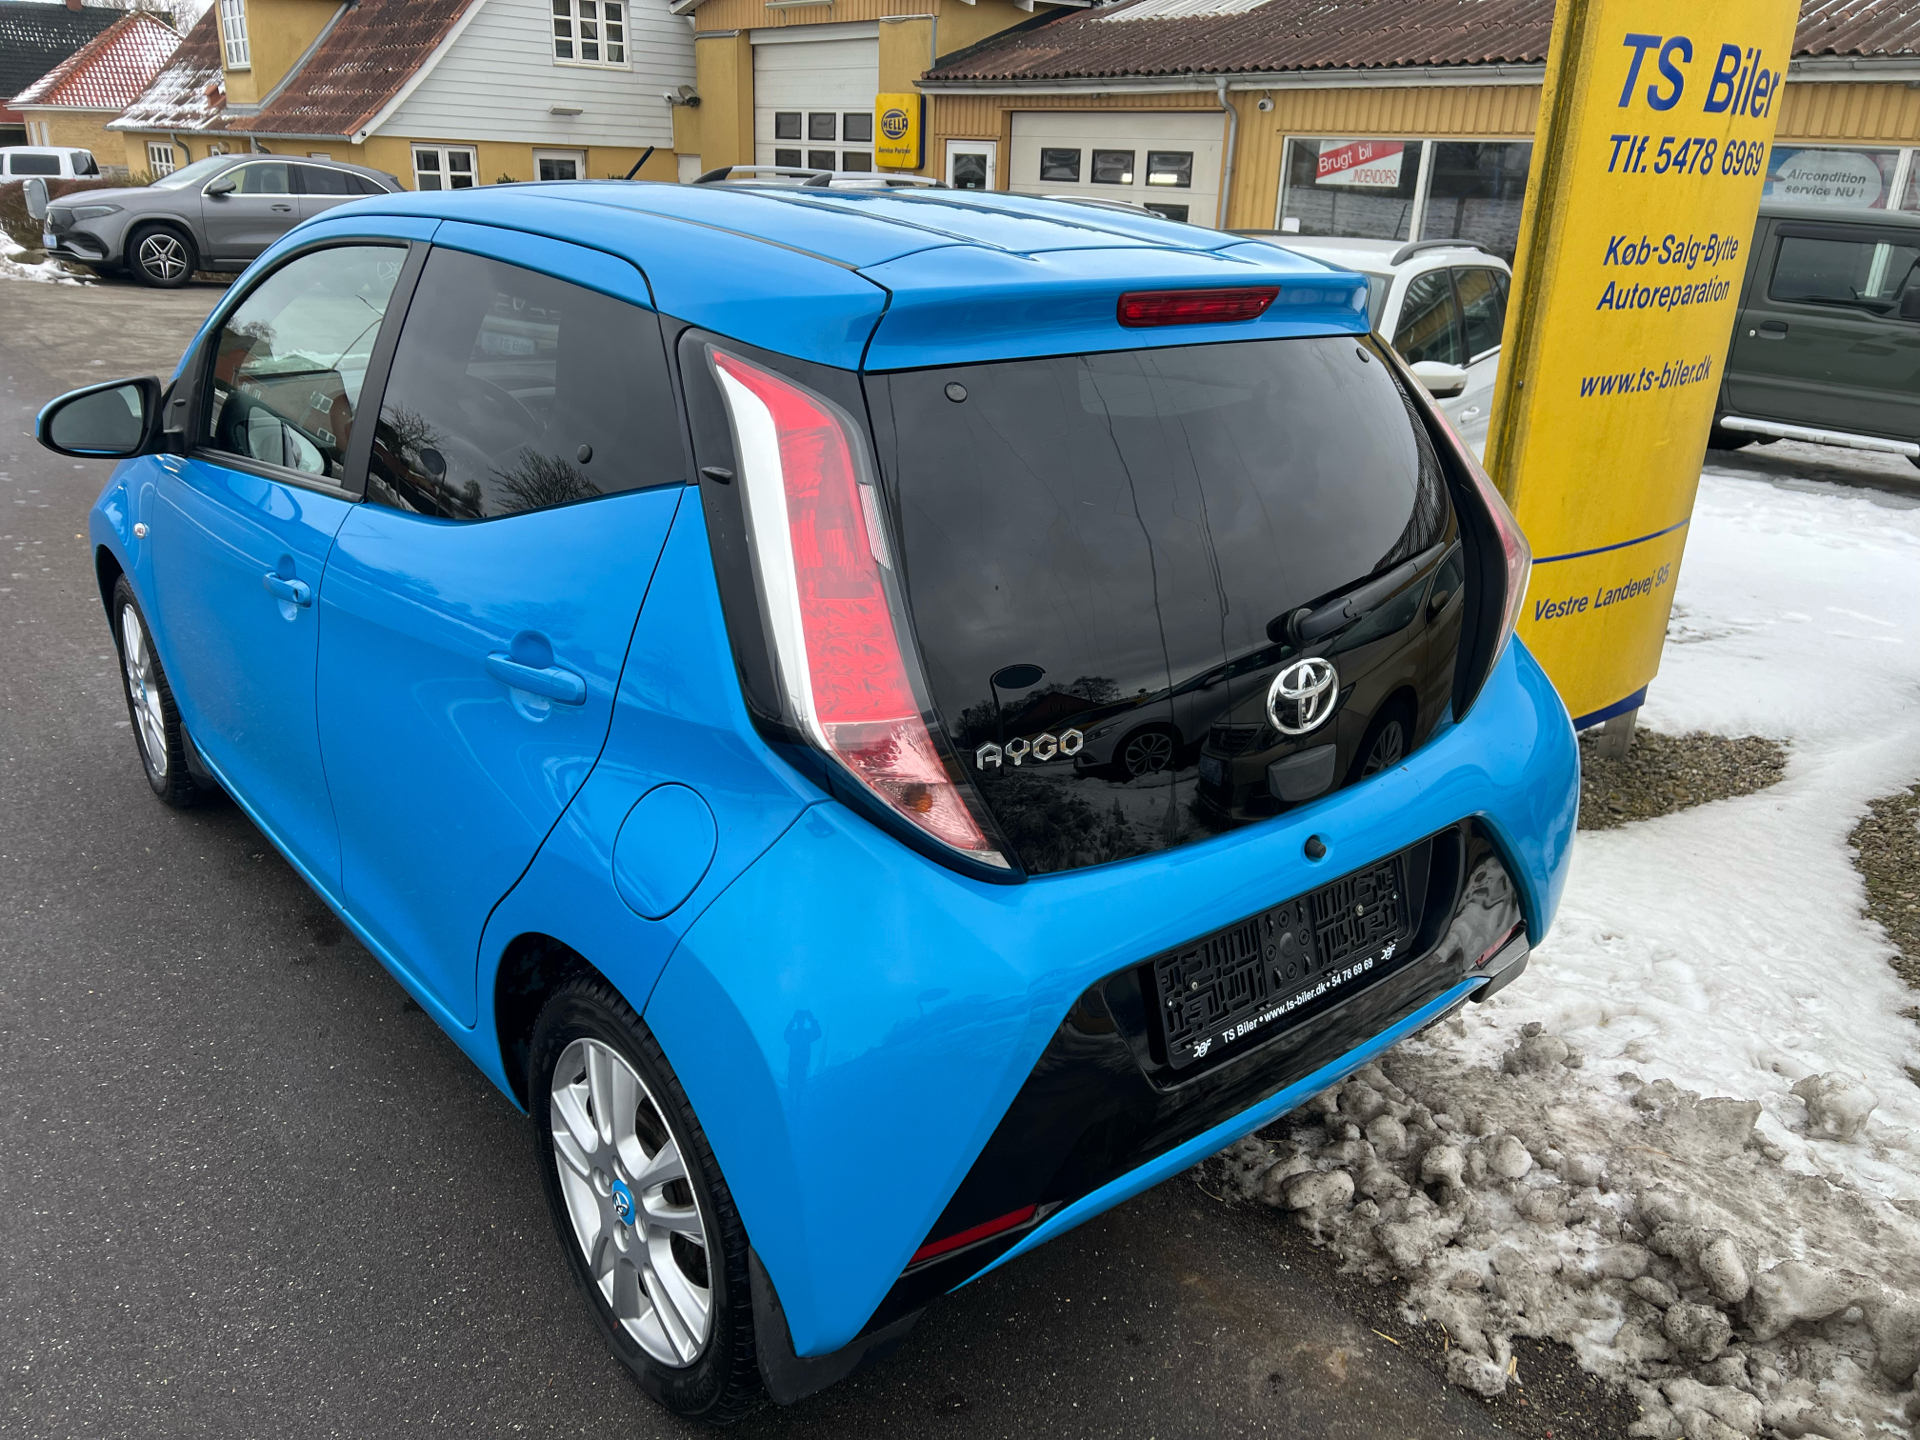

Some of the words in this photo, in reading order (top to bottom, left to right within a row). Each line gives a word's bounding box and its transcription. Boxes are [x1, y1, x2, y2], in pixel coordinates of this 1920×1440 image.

[1618, 33, 1693, 111] TS
[1703, 43, 1780, 118] Biler
[883, 118, 908, 130] HELLA
[894, 146, 911, 154] Partner
[1319, 150, 1352, 172] Brugt
[1358, 143, 1372, 160] bil
[1608, 134, 1651, 173] Tlf.
[1654, 136, 1718, 175] 5478
[1722, 139, 1764, 176] 6969
[1784, 184, 1831, 196] service
[1834, 187, 1856, 198] NU
[1786, 169, 1867, 185] Aircondition
[1603, 233, 1739, 270] Køb-Salg-Bytte
[1596, 274, 1730, 312] Autoreparation
[1580, 354, 1712, 398] www.ts-biler.dk
[1535, 596, 1588, 622] Vestre
[1593, 569, 1656, 608] Landevej
[1655, 562, 1671, 587] 95
[976, 728, 1084, 771] AYGO
[1222, 1029, 1236, 1043] TS
[1236, 1018, 1258, 1037] Biler
[1264, 983, 1327, 1022] www.ts-biler.dk
[1331, 973, 1342, 987] 54
[1342, 968, 1352, 981] 78
[1353, 963, 1363, 976] 69
[1364, 957, 1373, 970] 69
